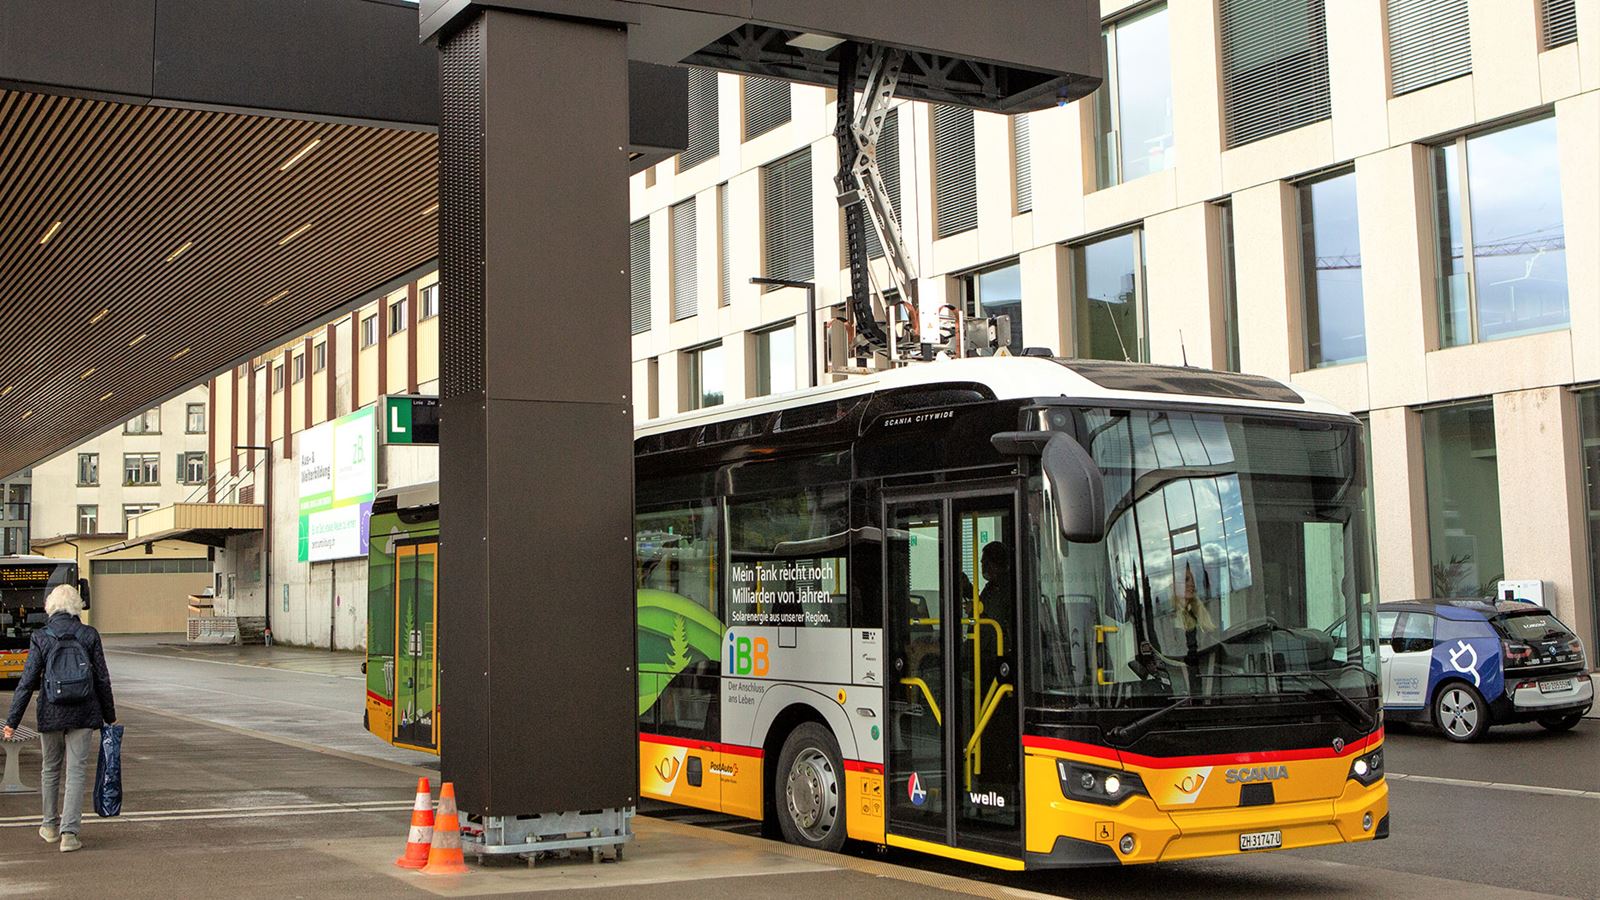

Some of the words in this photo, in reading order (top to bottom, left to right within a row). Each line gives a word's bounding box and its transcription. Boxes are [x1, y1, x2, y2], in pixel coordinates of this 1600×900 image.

[392, 406, 406, 432] L
[884, 417, 912, 427] SCANIA
[915, 411, 954, 422] CITYWIDE
[732, 564, 754, 582] Mein
[756, 564, 778, 582] Tank
[779, 563, 806, 581] reicht
[808, 562, 833, 580] noch
[732, 587, 776, 604] Milliarden
[777, 591, 795, 604] von
[796, 586, 833, 604] Jahren.
[732, 611, 769, 625] Solarenergie
[769, 613, 780, 622] aus
[780, 612, 805, 623] unserer
[805, 611, 831, 626] Region.
[729, 632, 770, 677] iBB
[728, 681, 738, 691] Der
[738, 681, 765, 694] Anschluss
[728, 694, 738, 704] ans
[738, 694, 755, 705] Leben
[710, 761, 734, 774] PostAuto
[1225, 766, 1288, 783] SCANIA
[969, 791, 1005, 808] welle
